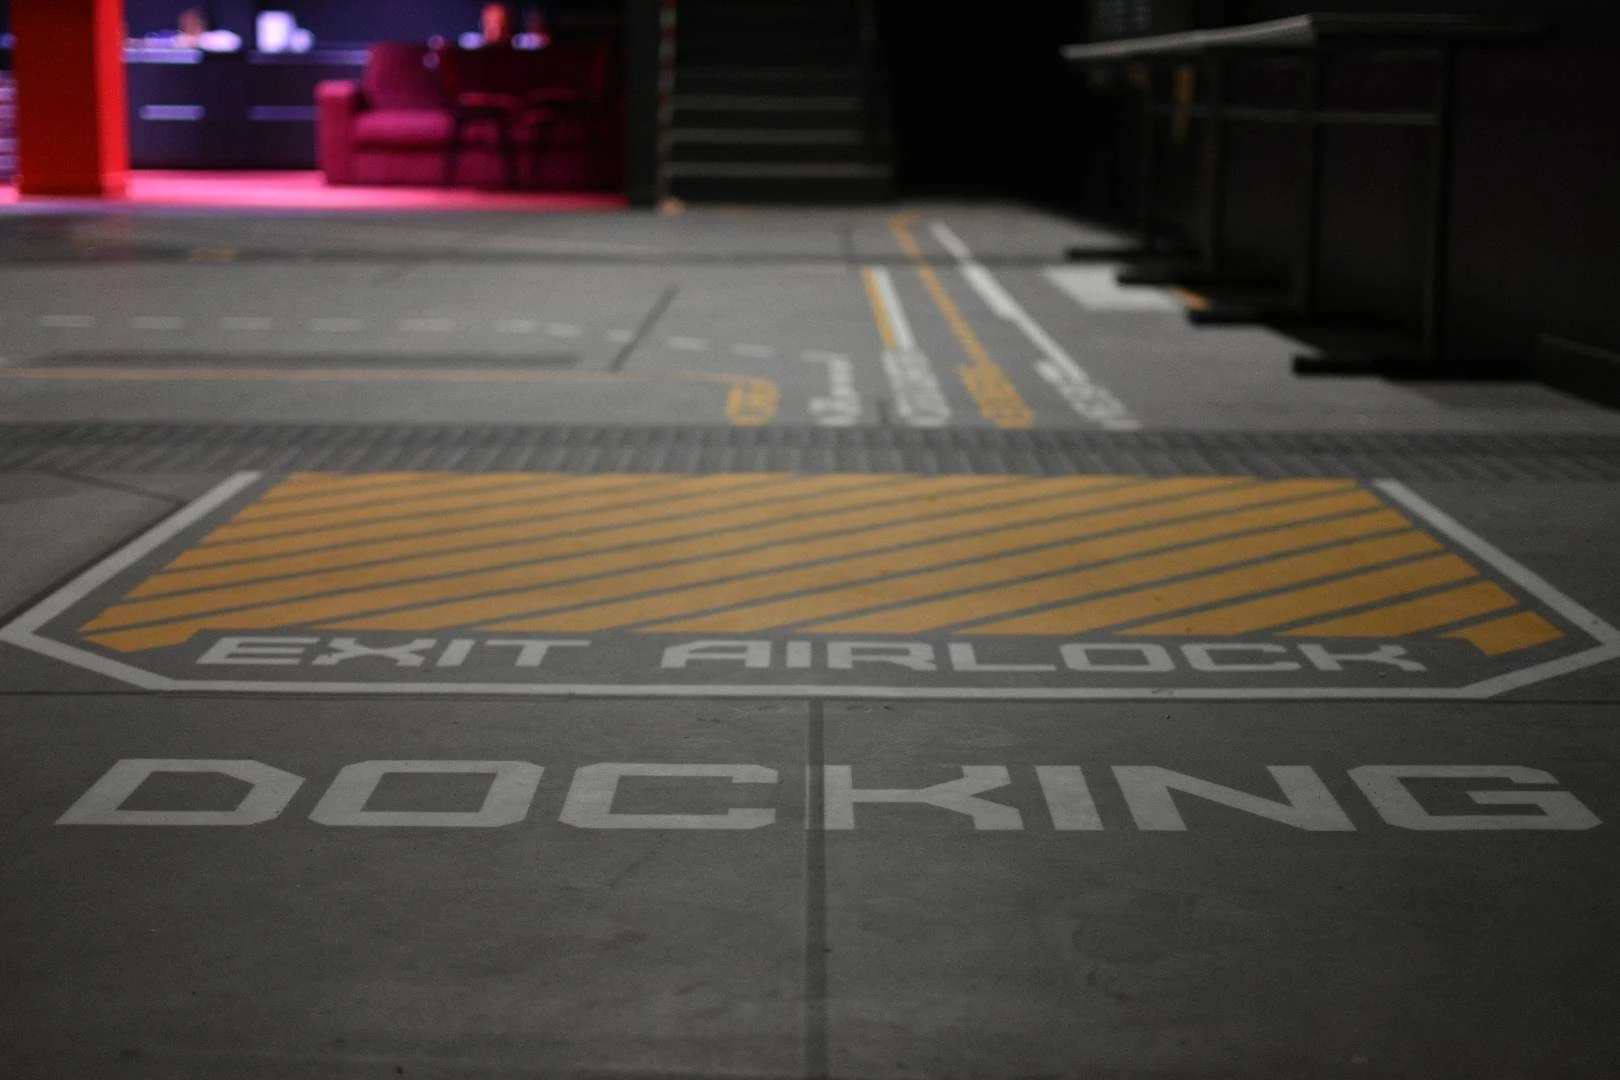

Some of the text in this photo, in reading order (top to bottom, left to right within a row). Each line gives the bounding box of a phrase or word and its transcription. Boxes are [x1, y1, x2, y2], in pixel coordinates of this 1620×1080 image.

[196, 636, 1427, 673] EXIT AIRLOCK
[54, 758, 1603, 832] DOCKING
